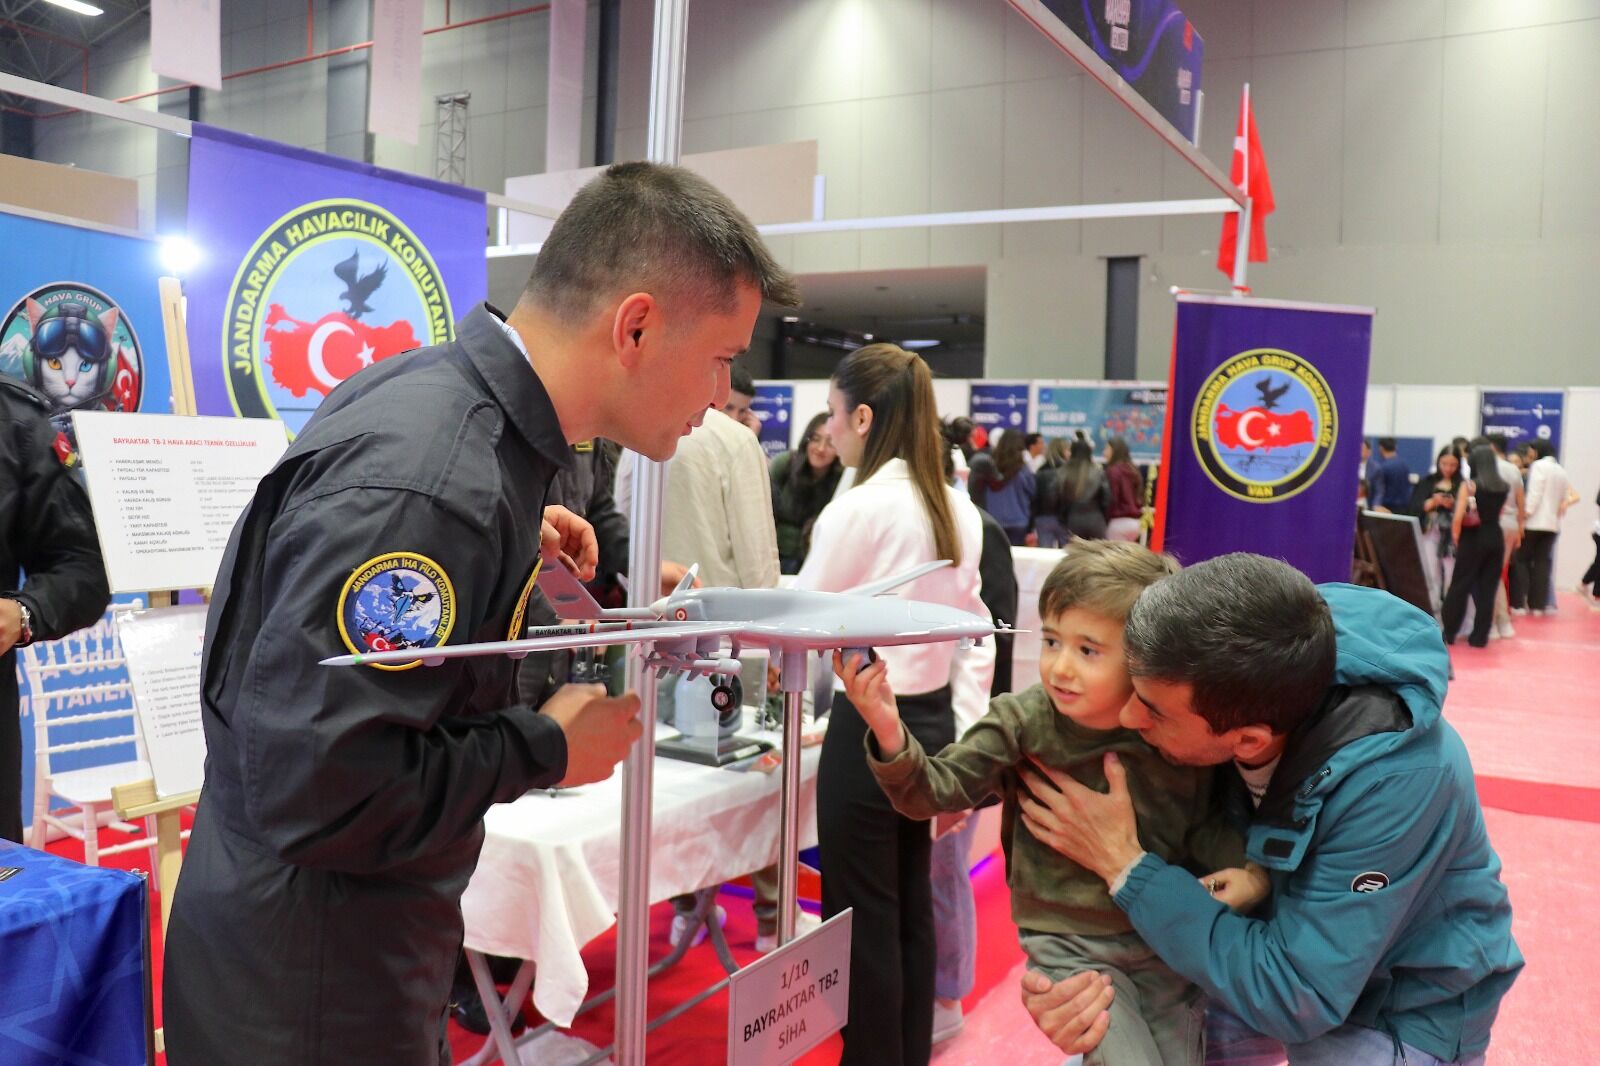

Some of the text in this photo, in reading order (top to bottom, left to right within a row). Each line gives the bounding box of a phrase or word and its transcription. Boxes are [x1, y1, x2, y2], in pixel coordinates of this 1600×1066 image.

[44, 292, 103, 311] HAVA GRUP
[233, 211, 448, 376] JANDARMA HAVACILIK KOMUTANL
[1227, 355, 1260, 377] HAVA
[1261, 354, 1296, 370] GRUP
[113, 437, 150, 445] BAYRAKTAR
[1247, 485, 1273, 497] VAN
[352, 559, 399, 593] JANDARMA
[535, 627, 587, 636] BAYRAKTAR TB2
[780, 959, 809, 990] 1/10
[743, 968, 839, 1043] BAYRAKTAR TB2
[778, 1018, 807, 1050] SİHA
